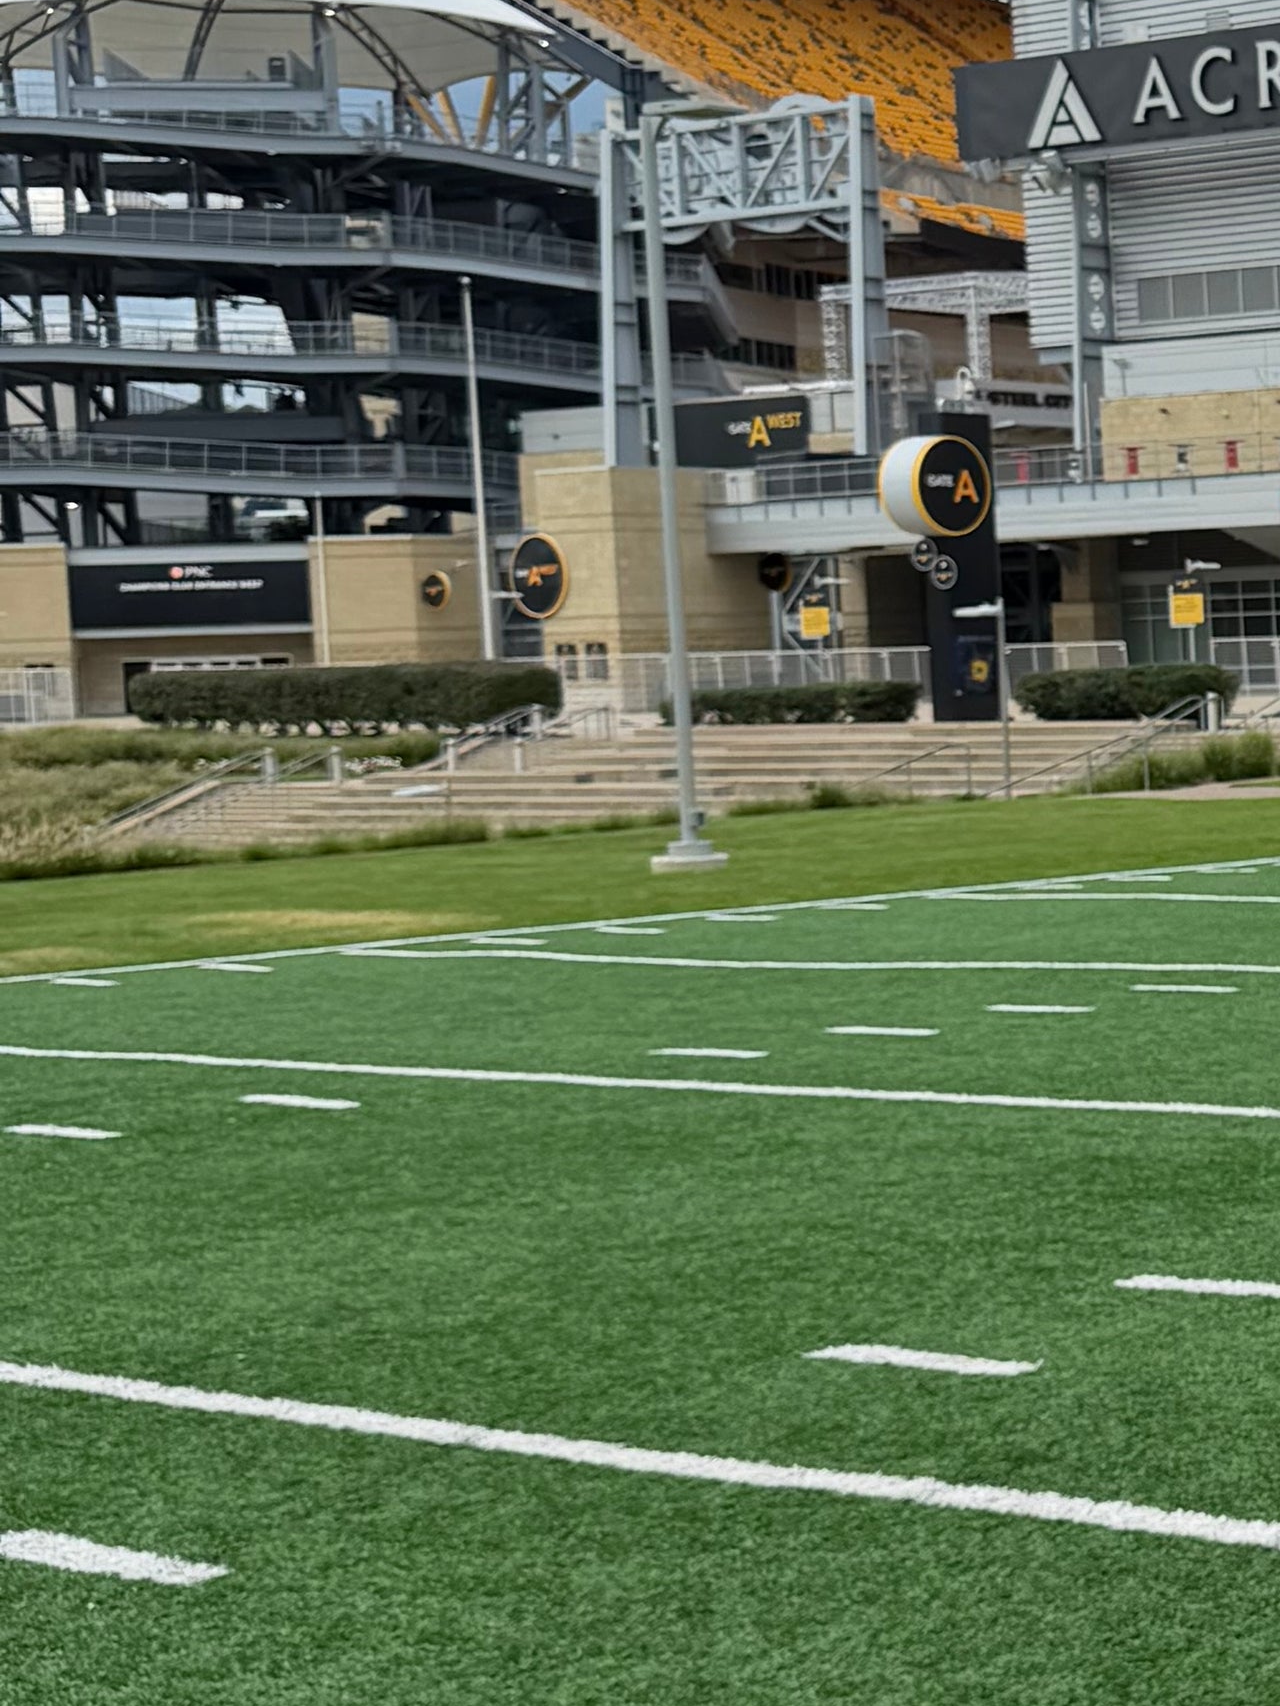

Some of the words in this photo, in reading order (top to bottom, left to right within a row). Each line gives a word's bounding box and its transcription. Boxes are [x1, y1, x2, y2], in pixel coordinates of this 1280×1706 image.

[747, 415, 771, 448] A
[766, 412, 802, 429] WEST
[927, 473, 954, 488] GATE
[953, 469, 980, 504] A
[184, 565, 214, 578] PNC
